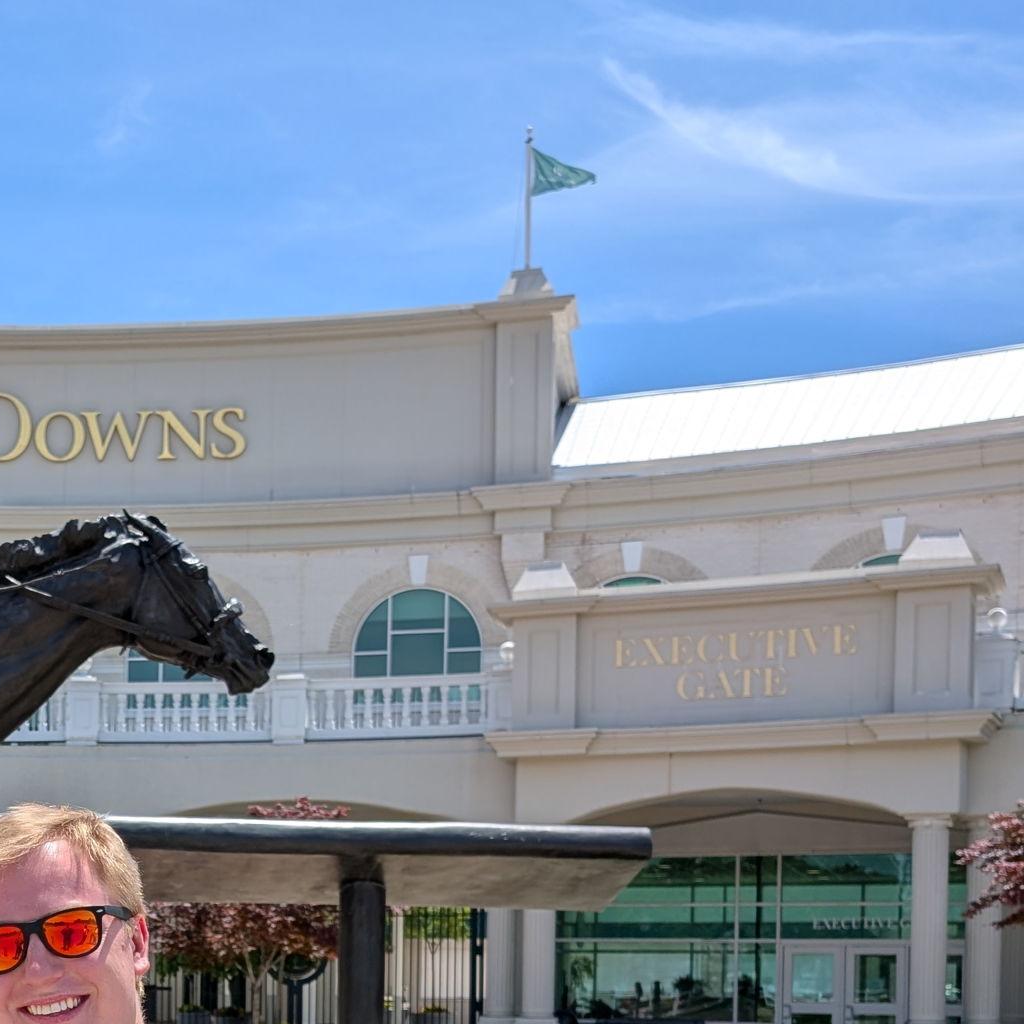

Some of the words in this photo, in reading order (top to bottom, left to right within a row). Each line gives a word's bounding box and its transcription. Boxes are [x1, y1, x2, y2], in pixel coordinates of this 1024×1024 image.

[614, 623, 857, 669] EXECUTIVE
[676, 666, 788, 701] GATE
[812, 917, 897, 931] EXECUTIVE
